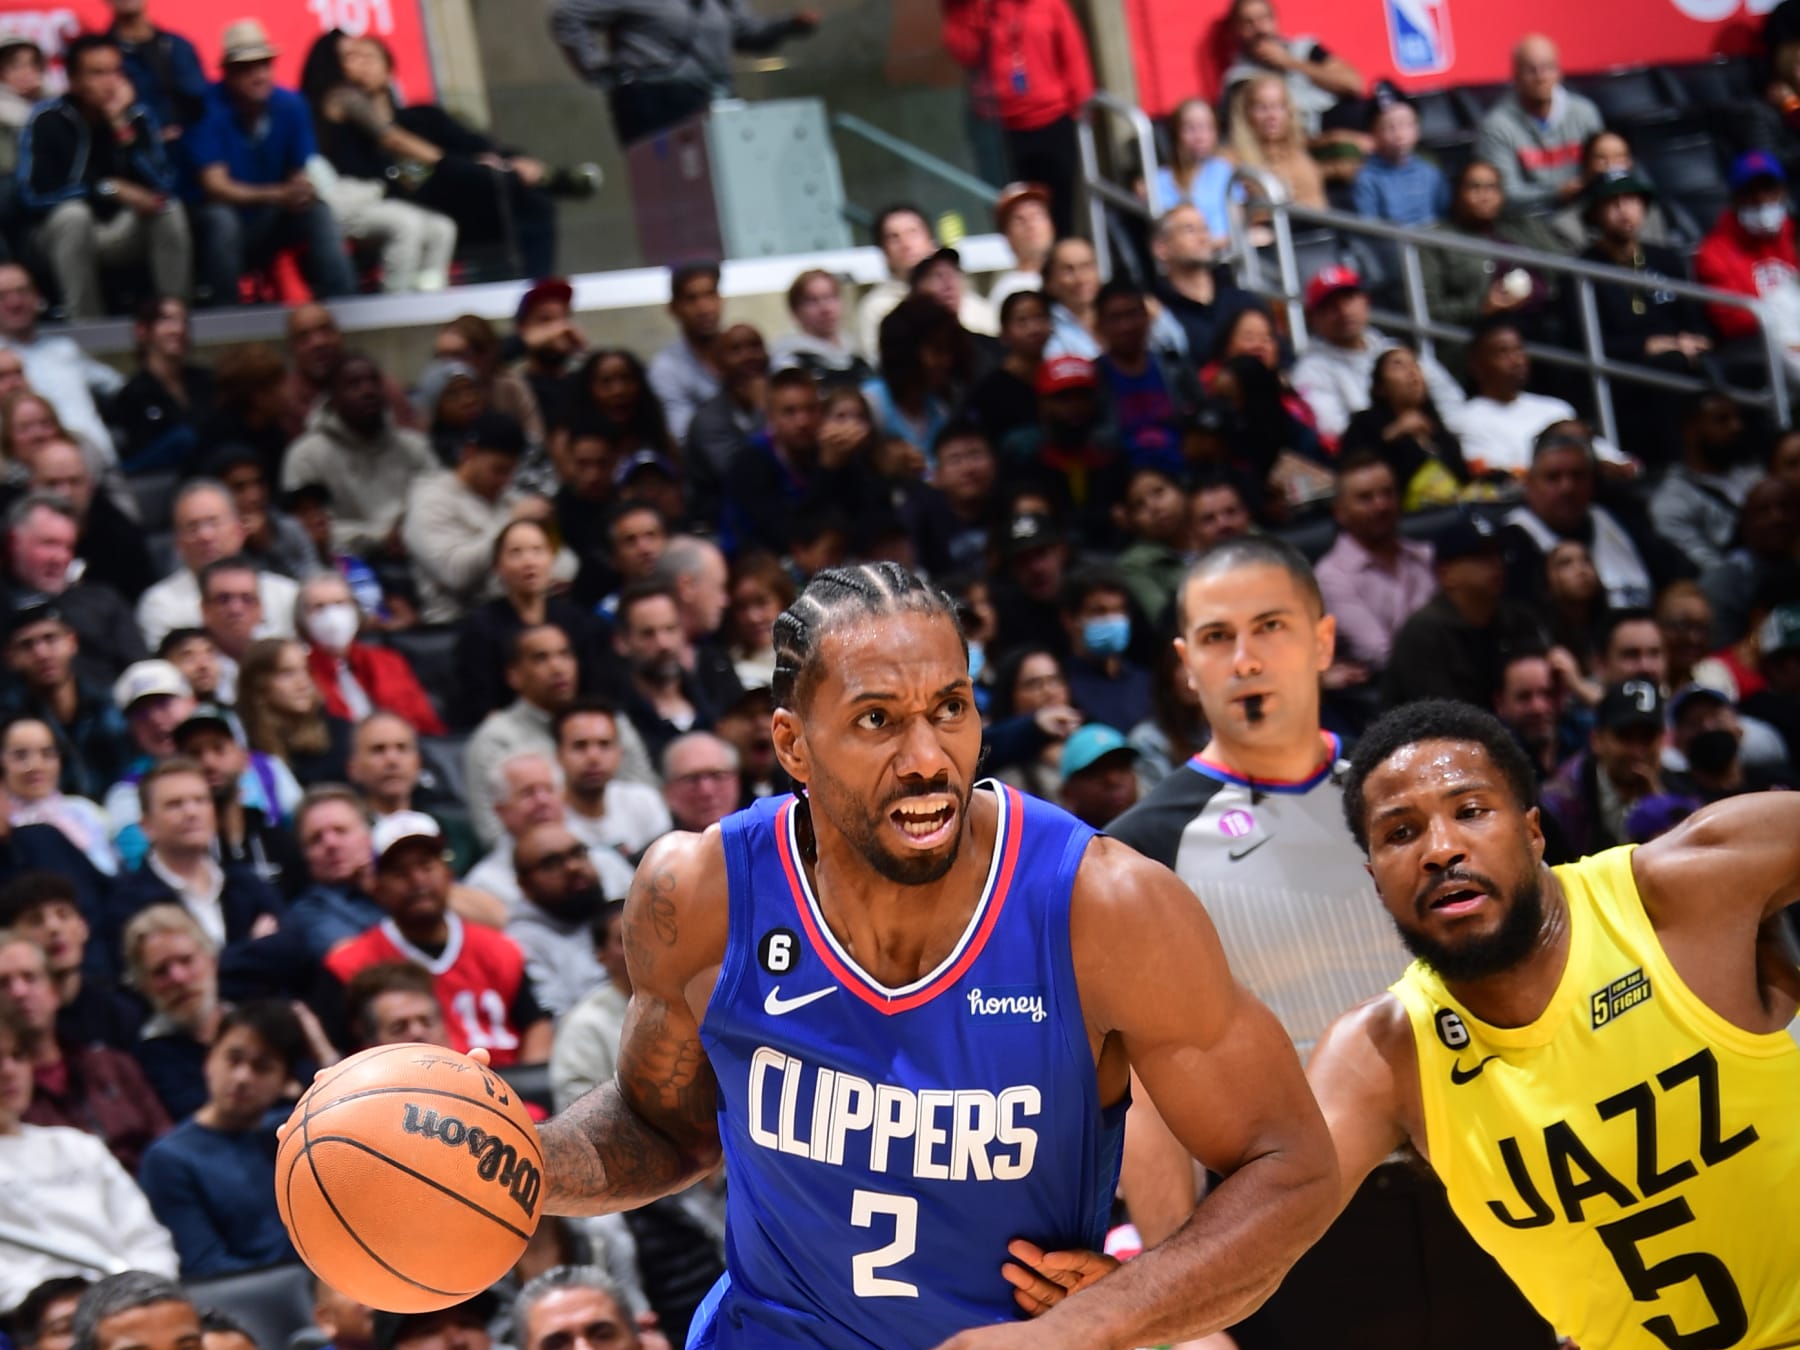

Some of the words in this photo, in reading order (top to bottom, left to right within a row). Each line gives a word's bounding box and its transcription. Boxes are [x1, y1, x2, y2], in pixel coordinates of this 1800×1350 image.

[768, 934, 792, 971] 6
[451, 989, 519, 1050] 11
[966, 987, 1048, 1023] honey
[1593, 991, 1608, 1025] 5
[1613, 983, 1649, 1015] FIGHT
[1440, 1013, 1468, 1046] 6
[748, 1046, 1041, 1181] CLIPPERS
[1486, 1047, 1760, 1229] JAZZ
[402, 1102, 542, 1220] Wilson
[850, 1189, 919, 1298] 2
